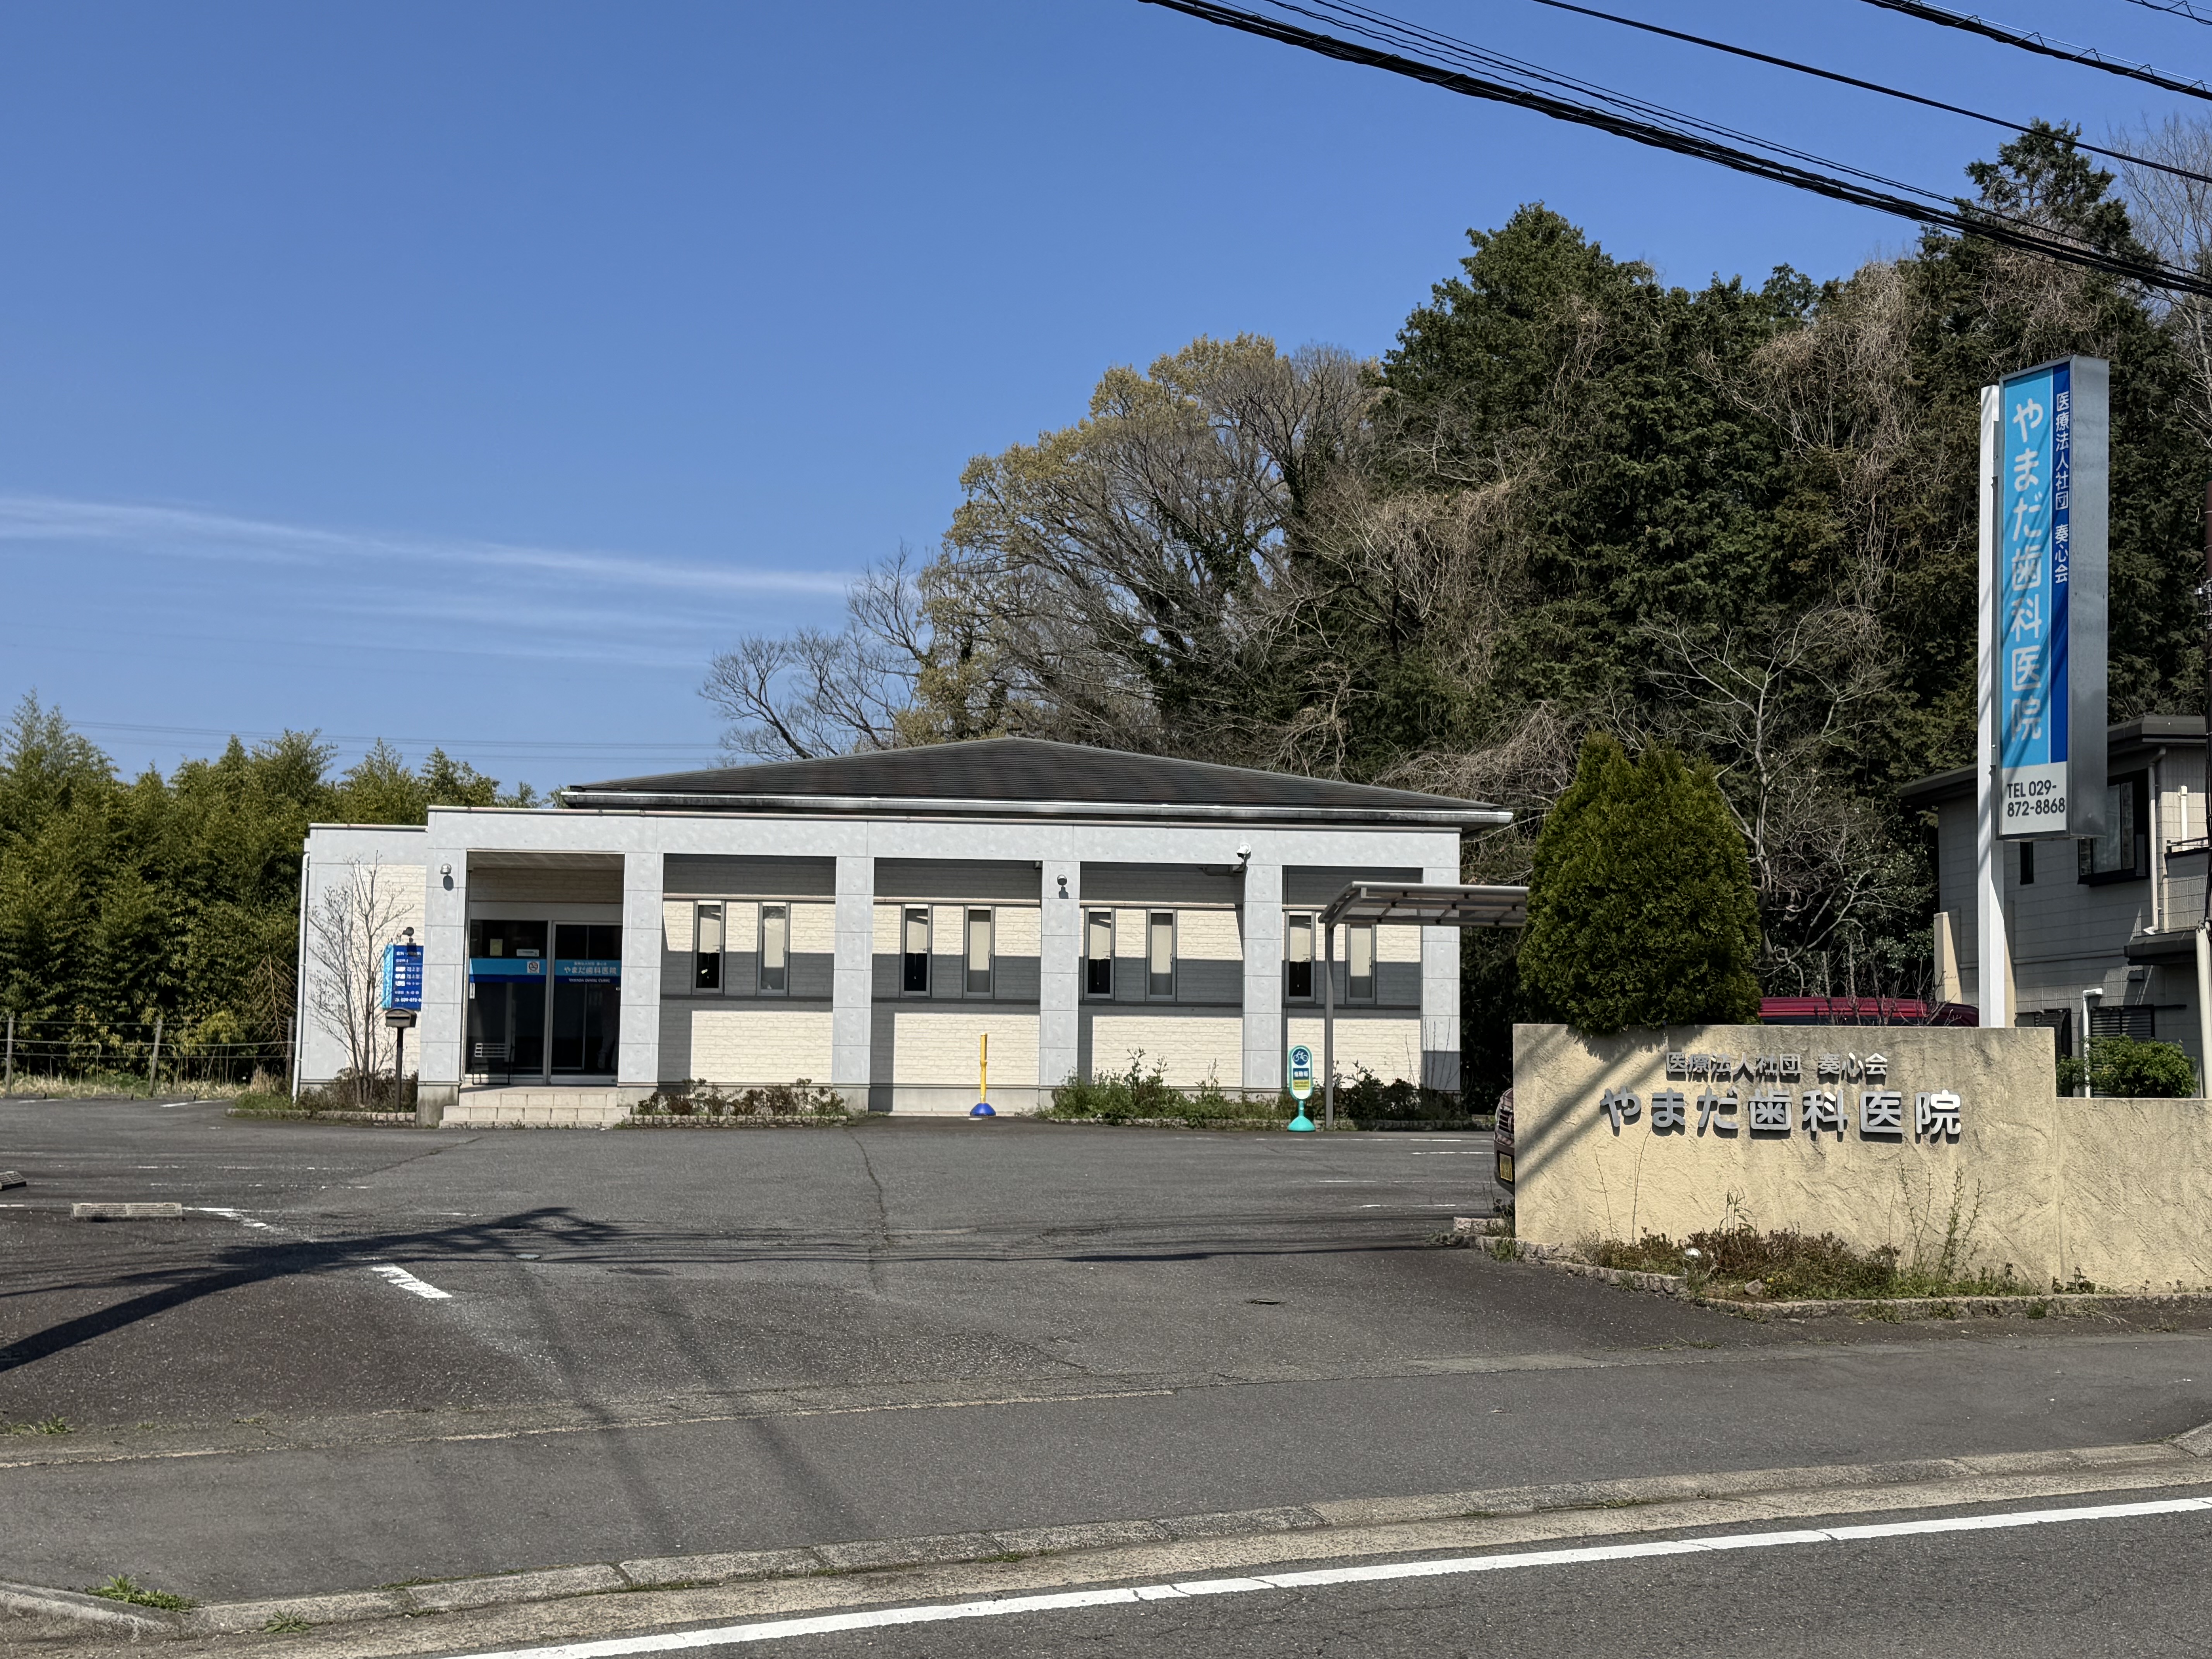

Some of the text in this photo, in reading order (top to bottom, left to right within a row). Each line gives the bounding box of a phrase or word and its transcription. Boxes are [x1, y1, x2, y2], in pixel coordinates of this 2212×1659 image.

[2055, 391, 2069, 584] 医療法人社団 奏心会
[2011, 398, 2043, 741] やまだ歯科医院
[2007, 780, 2057, 798] TEL 029-
[2007, 797, 2065, 817] 872-8868
[1666, 1051, 1887, 1075] 医療法人社団 奏心会
[1599, 1085, 1961, 1135] やまだ歯科医院
